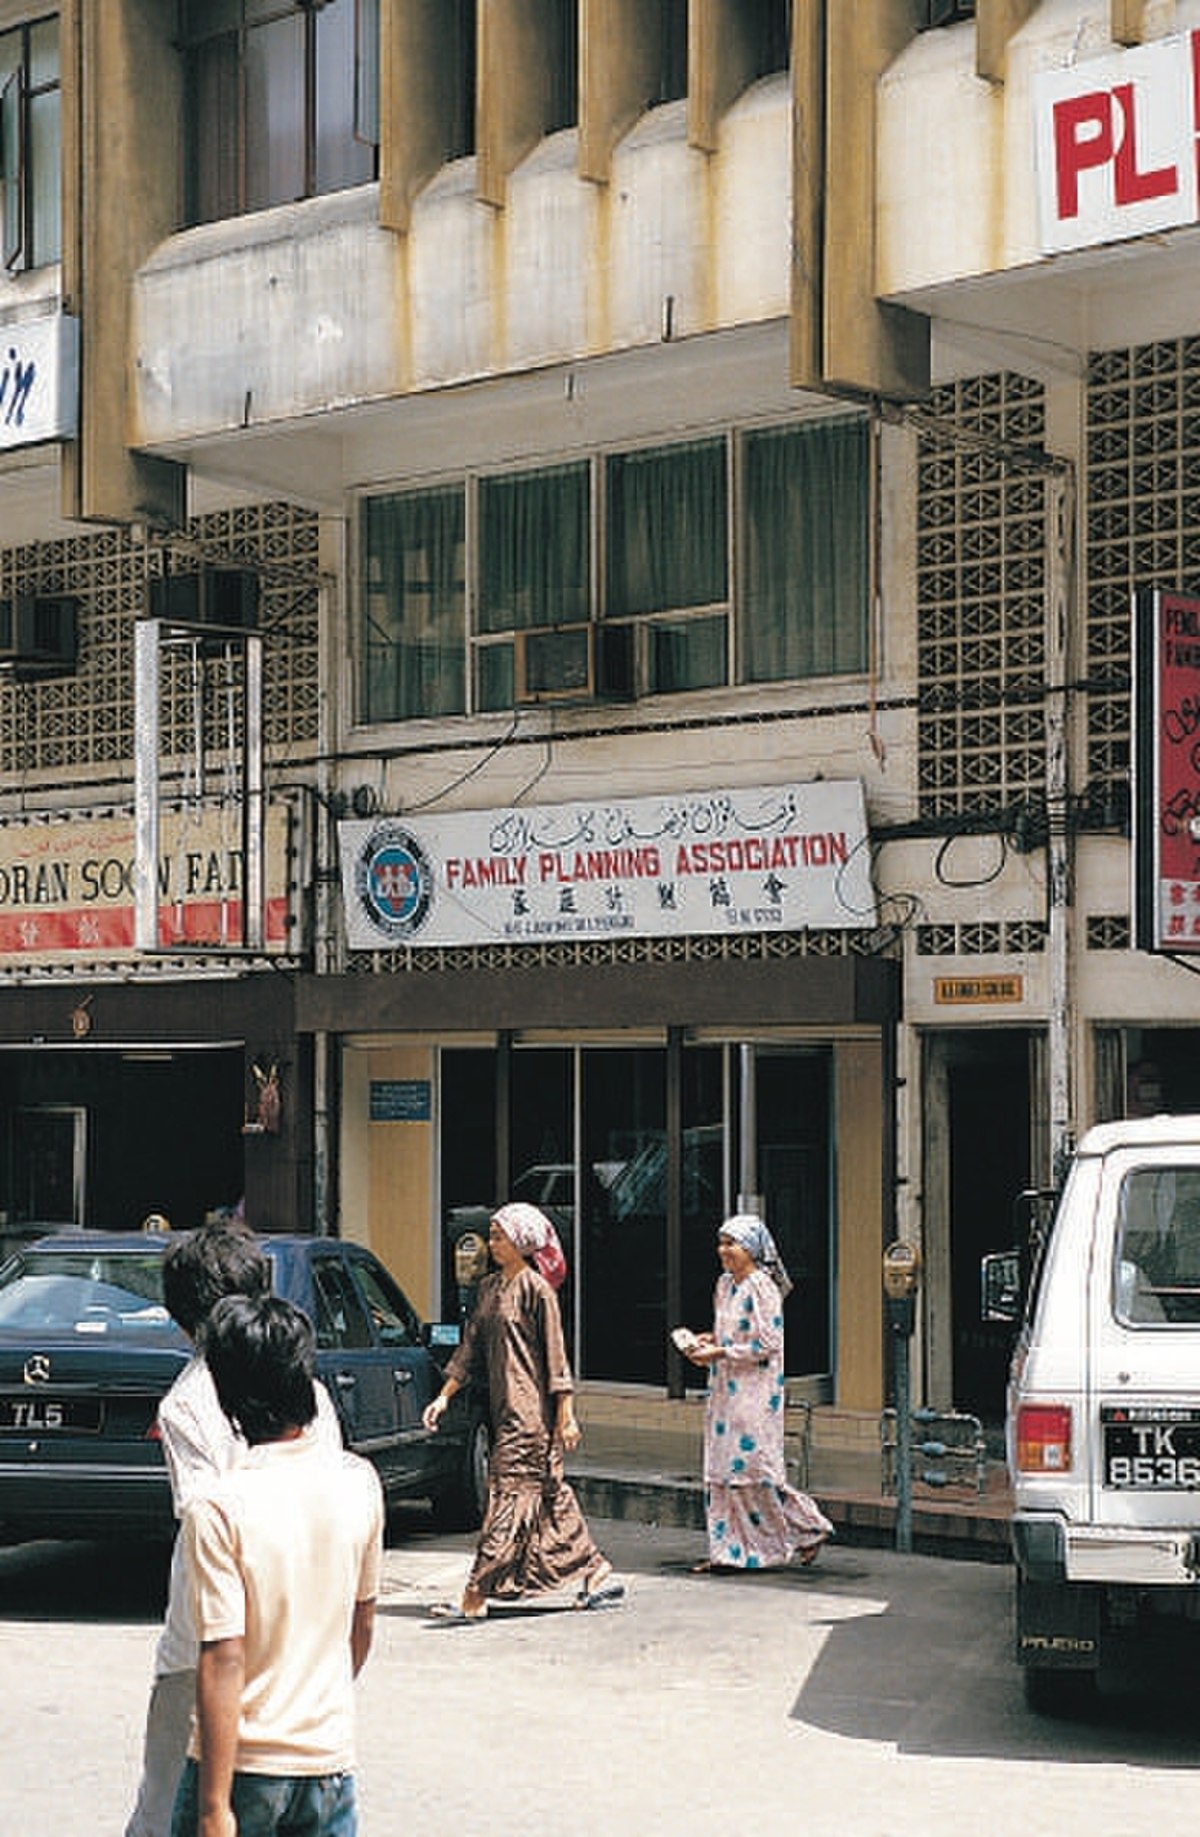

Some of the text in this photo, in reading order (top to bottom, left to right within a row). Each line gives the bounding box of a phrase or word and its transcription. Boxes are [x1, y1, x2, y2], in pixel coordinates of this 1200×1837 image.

[446, 831, 848, 889] FAMILY PLANNING ASSOCIATION
[1132, 1426, 1177, 1456] TK
